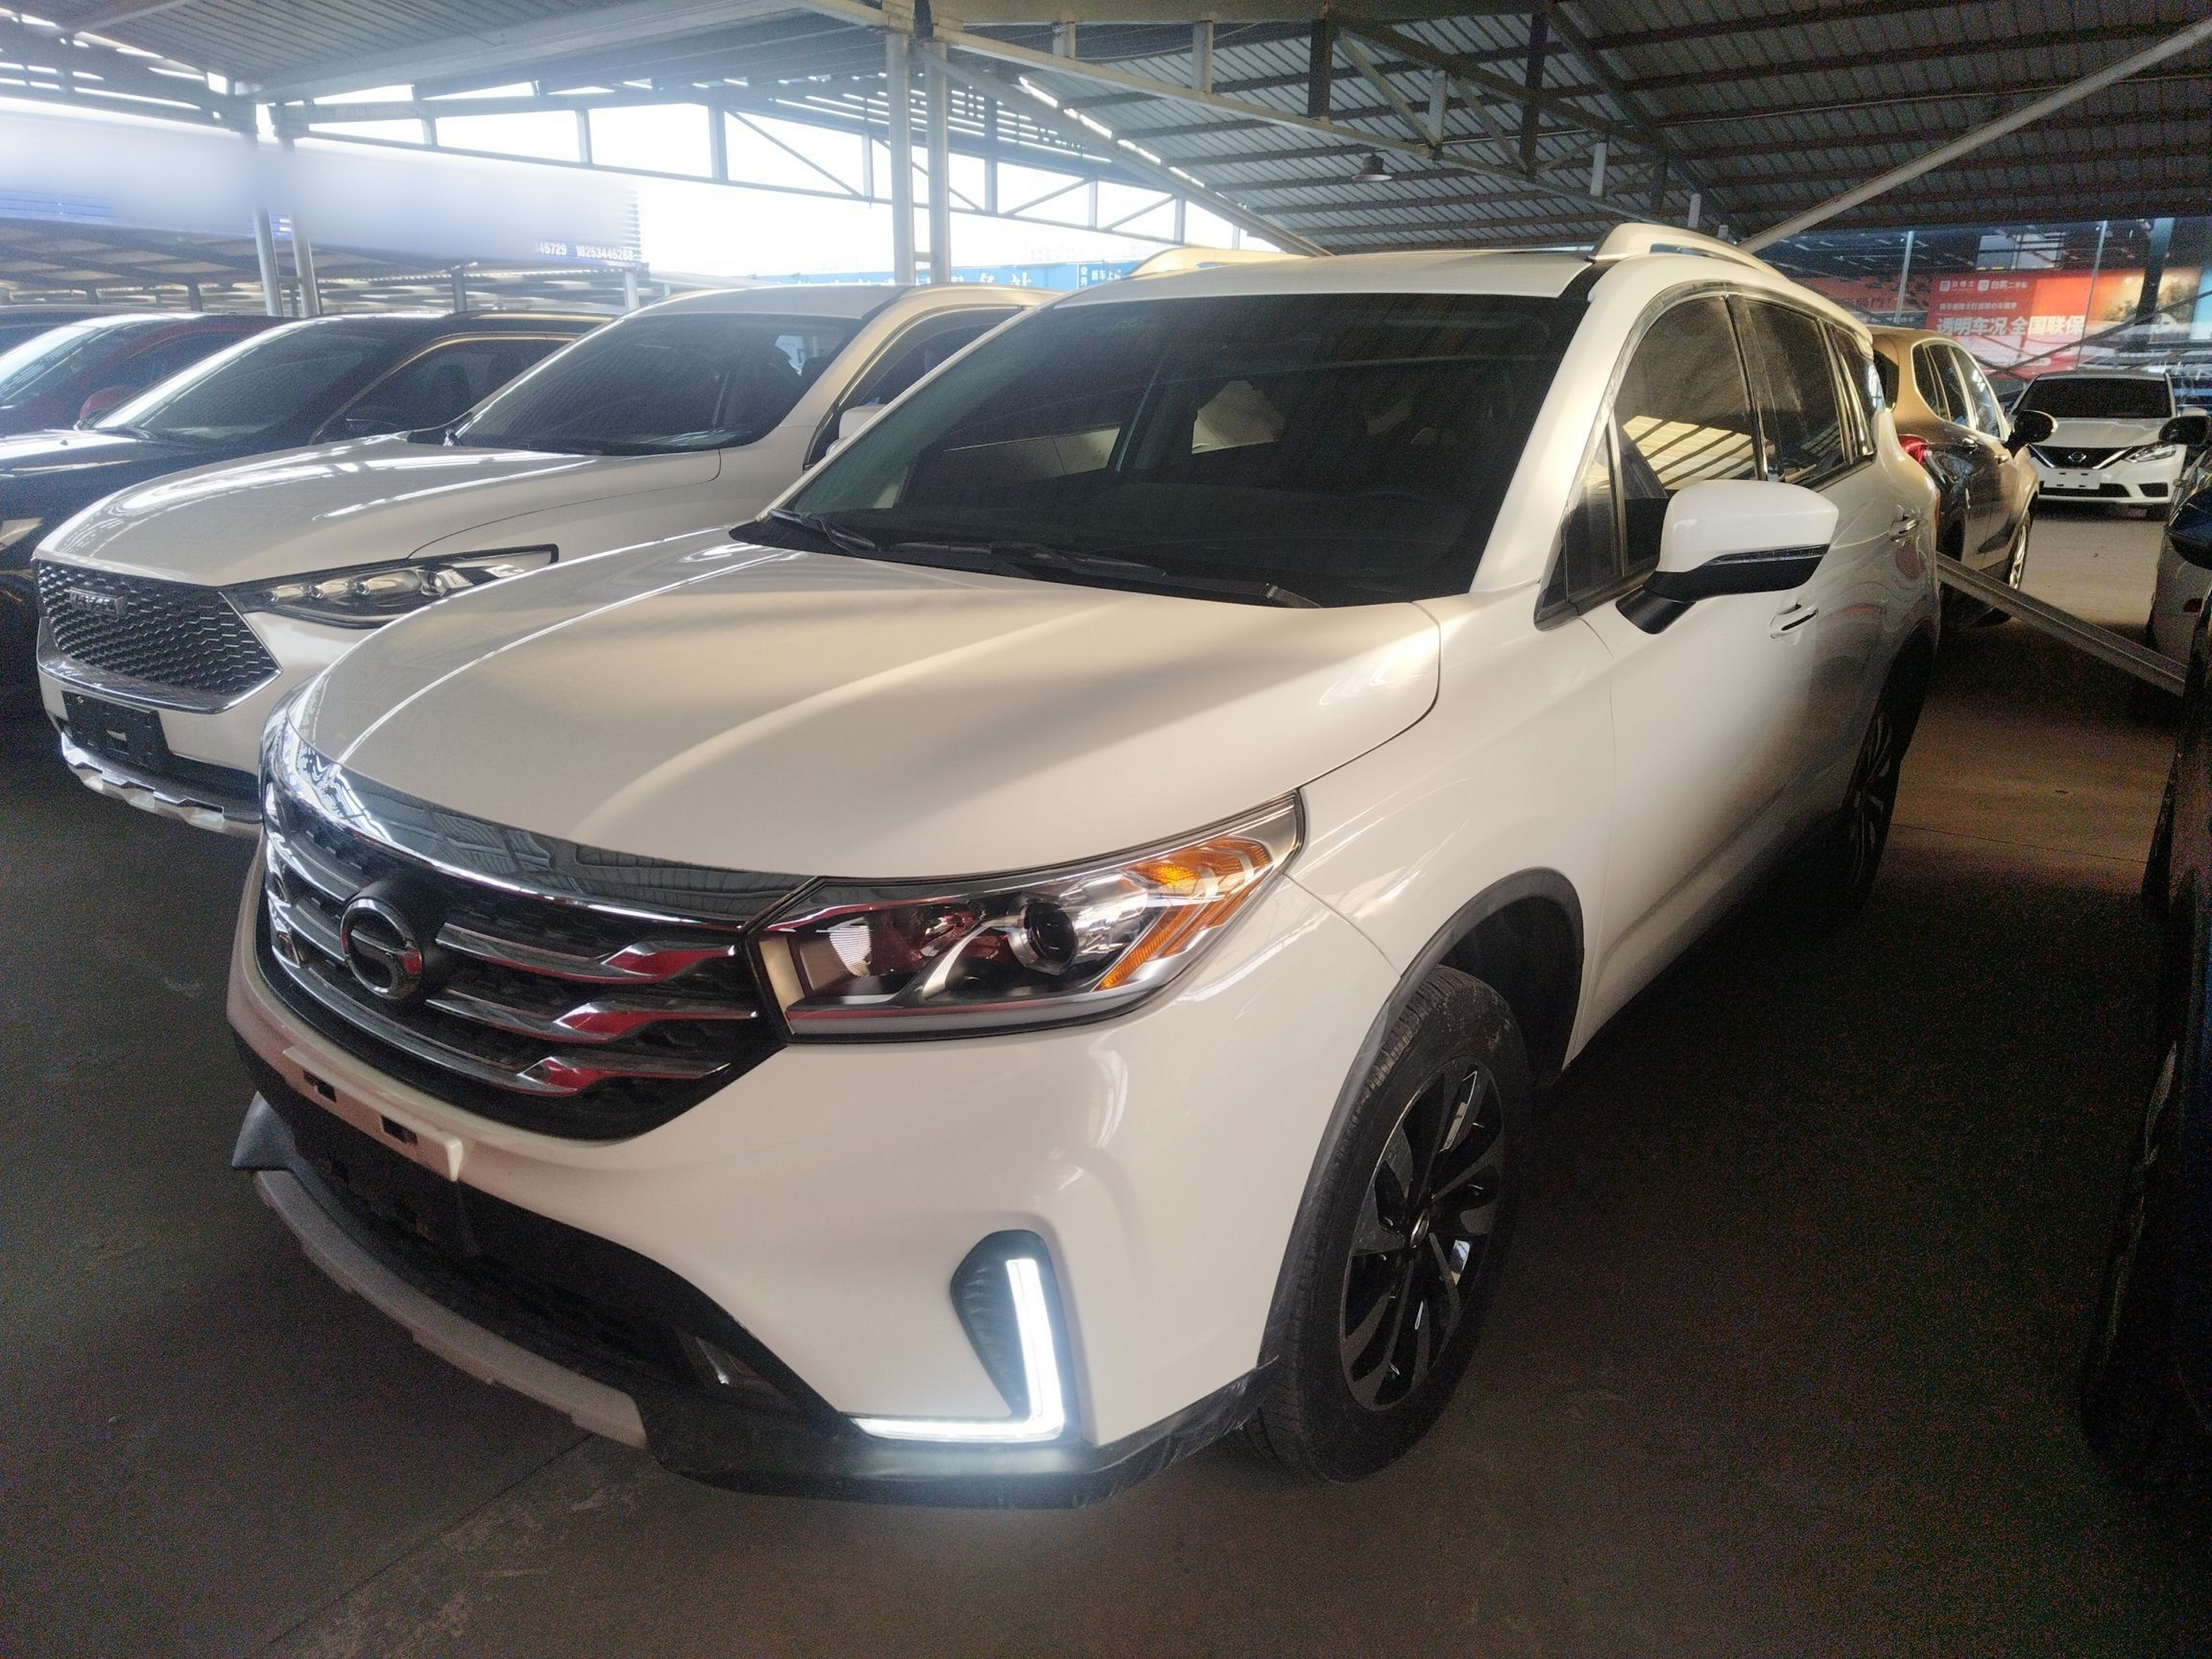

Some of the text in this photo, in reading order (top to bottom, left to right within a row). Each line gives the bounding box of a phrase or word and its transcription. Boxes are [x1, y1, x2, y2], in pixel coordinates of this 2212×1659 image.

[1937, 317, 2008, 336] 透明车况
[2010, 315, 2086, 336] 全国联保
